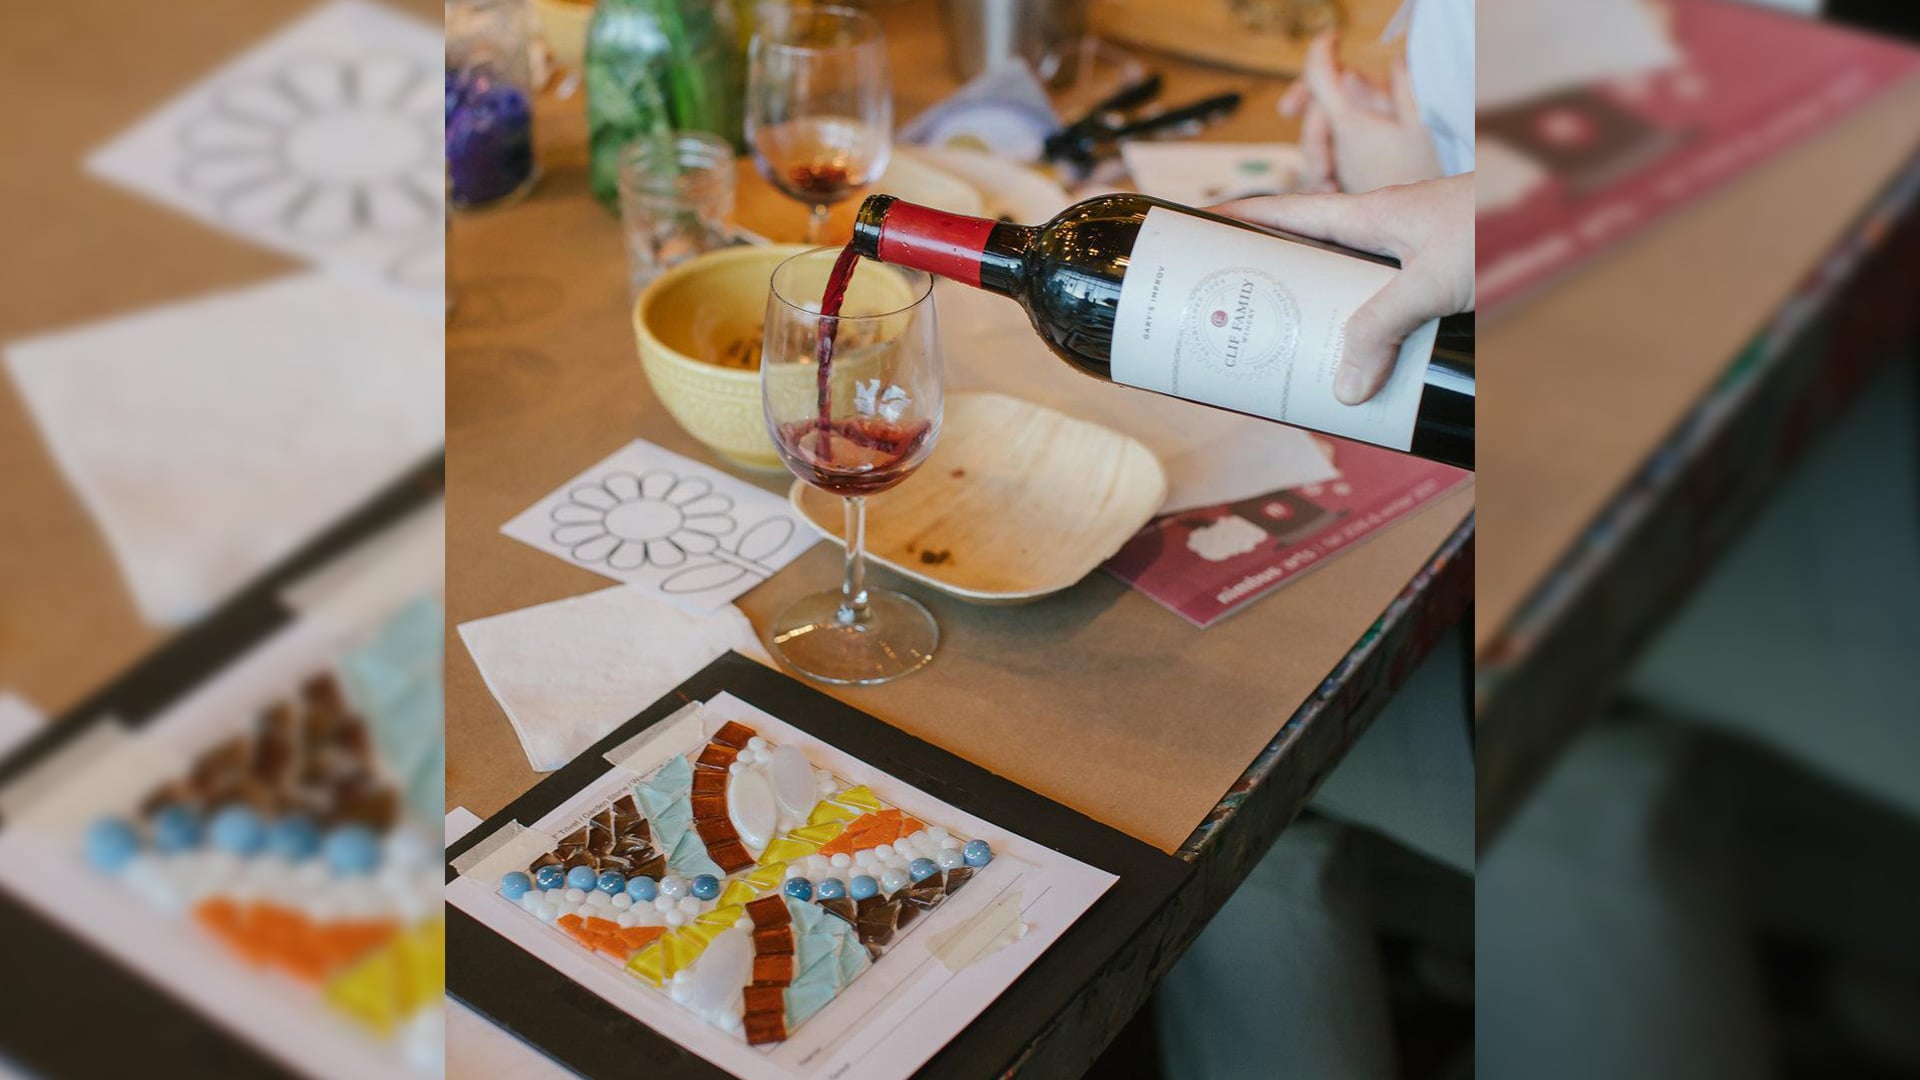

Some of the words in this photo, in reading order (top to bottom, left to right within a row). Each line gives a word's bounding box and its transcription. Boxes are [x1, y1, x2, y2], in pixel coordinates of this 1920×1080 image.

[1143, 306, 1156, 341] GARY'S
[1150, 266, 1165, 303] IMPROV
[1231, 278, 1255, 328] FAMILY
[1242, 308, 1256, 345] WINERY
[1224, 328, 1241, 368] CLIF
[582, 800, 609, 819] Garden
